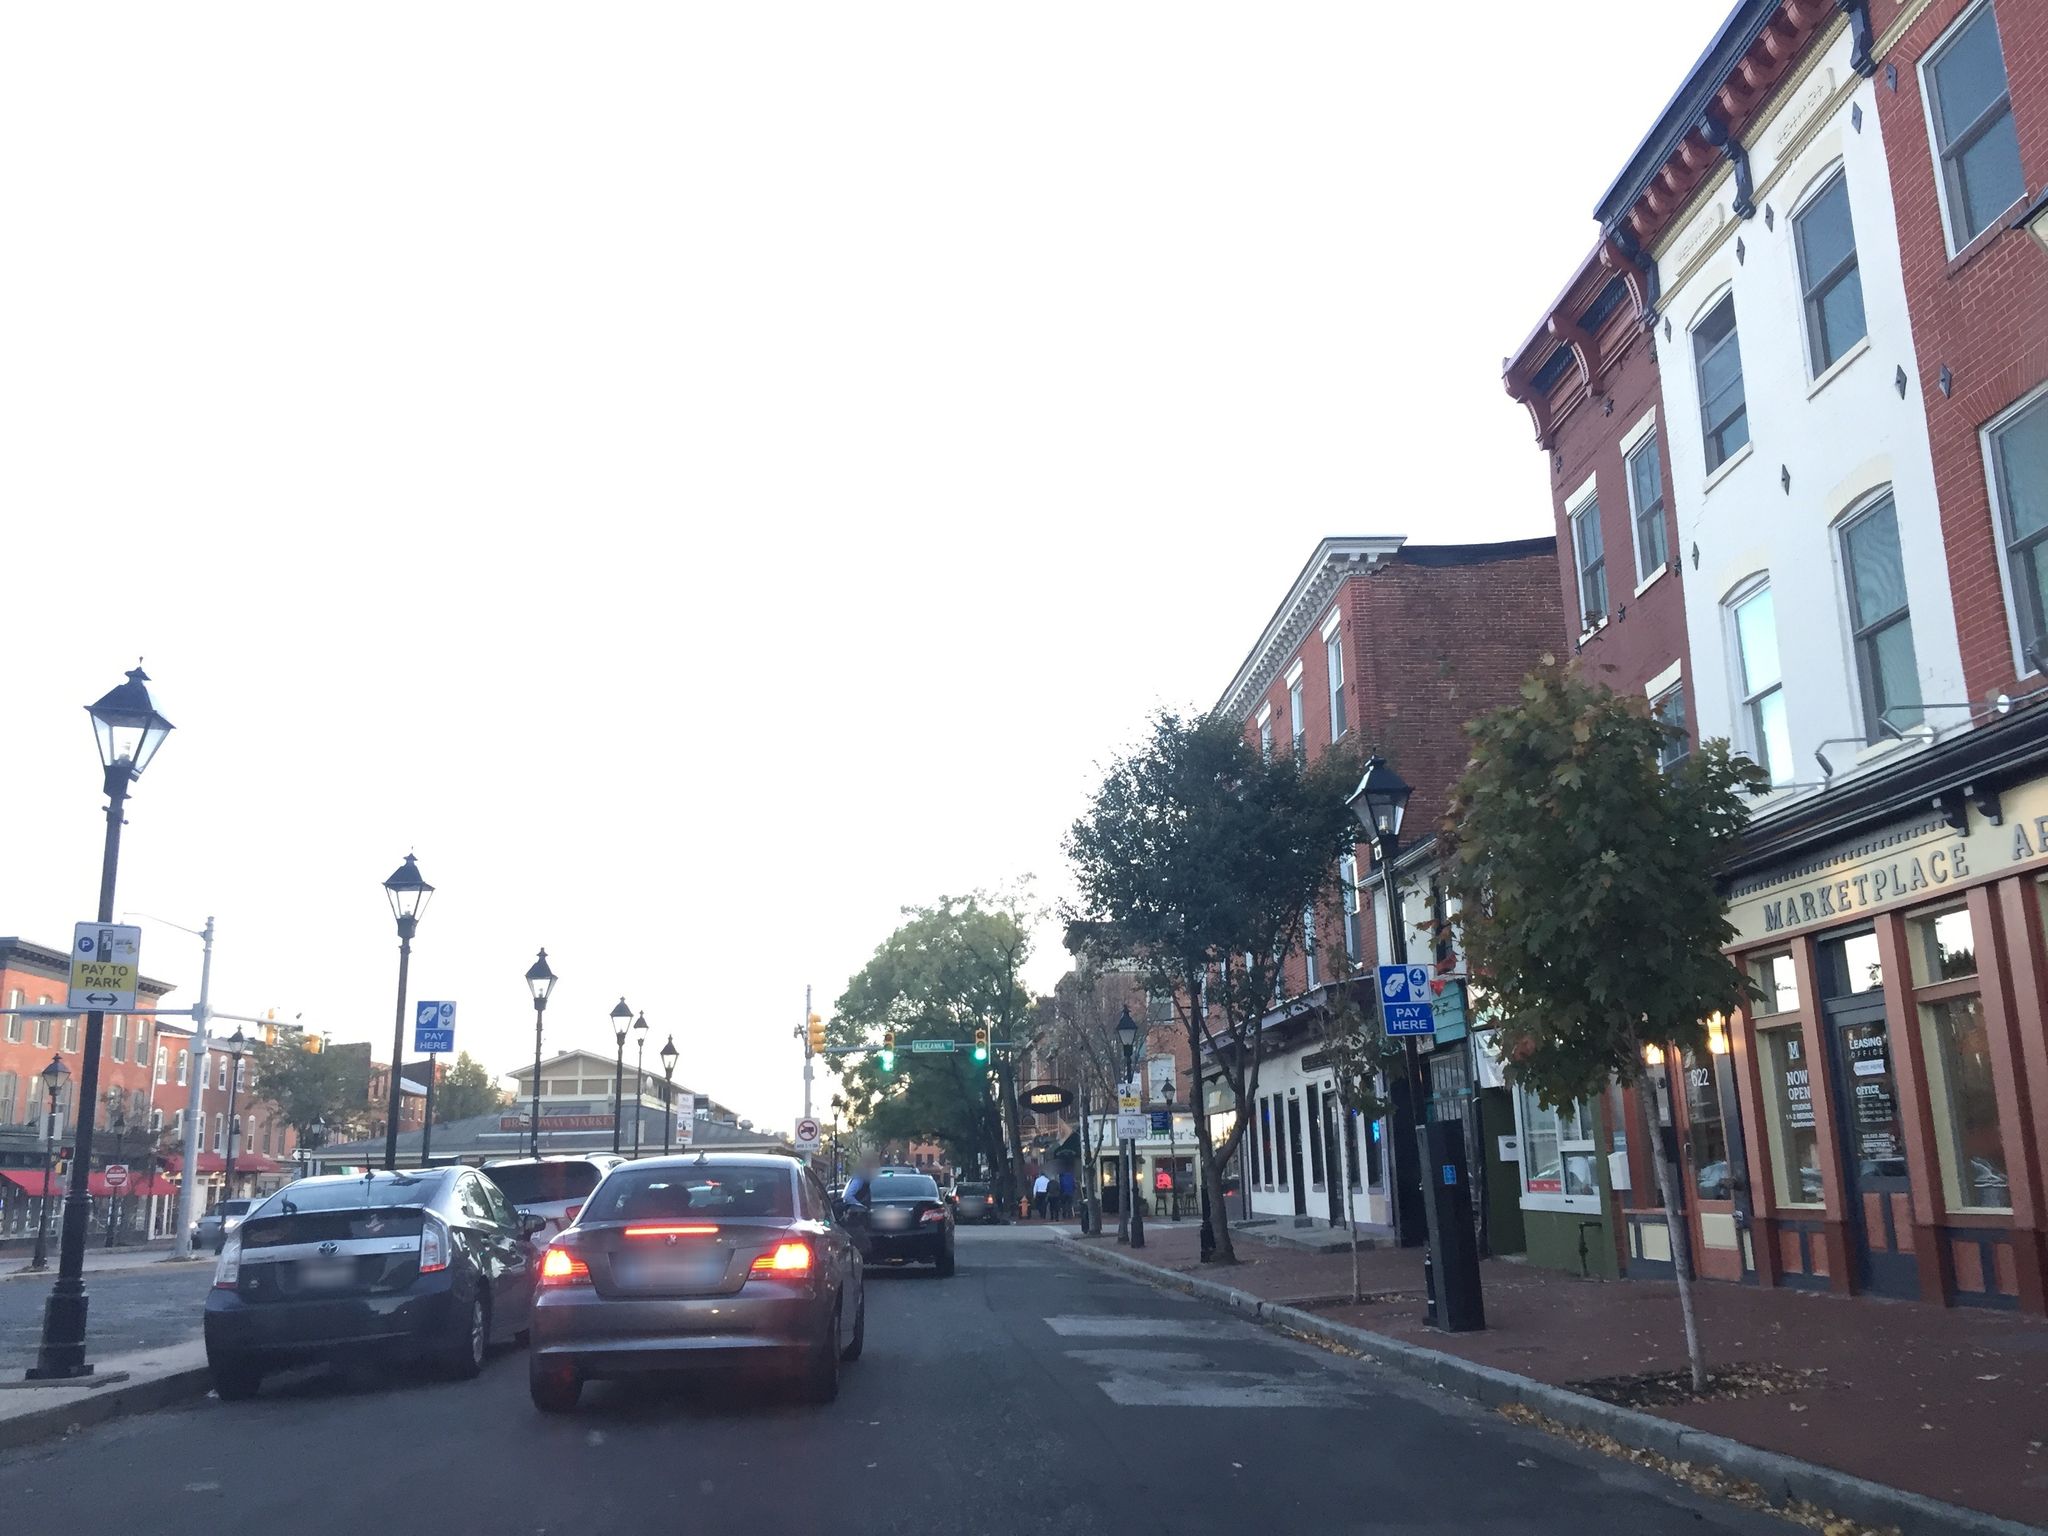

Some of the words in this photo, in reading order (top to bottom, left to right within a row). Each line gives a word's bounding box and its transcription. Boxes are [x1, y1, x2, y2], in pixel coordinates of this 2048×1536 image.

[1763, 843, 1969, 932] MARKETPLACE
[81, 964, 106, 975] PAY
[110, 965, 129, 976] TO
[1413, 968, 1422, 981] 4
[85, 976, 122, 988] PARK
[1396, 1007, 1420, 1018] PAY
[1393, 1020, 1428, 1030] HERE
[424, 1032, 444, 1040] PAY
[420, 1041, 448, 1050] HERE
[1849, 1037, 1882, 1049] LEASING
[1851, 1049, 1884, 1059] OFFICE
[1691, 1068, 1709, 1087] 622
[1786, 1070, 1808, 1086] NOW
[1788, 1086, 1811, 1101] OPEN
[1856, 1085, 1879, 1096] OFFICE
